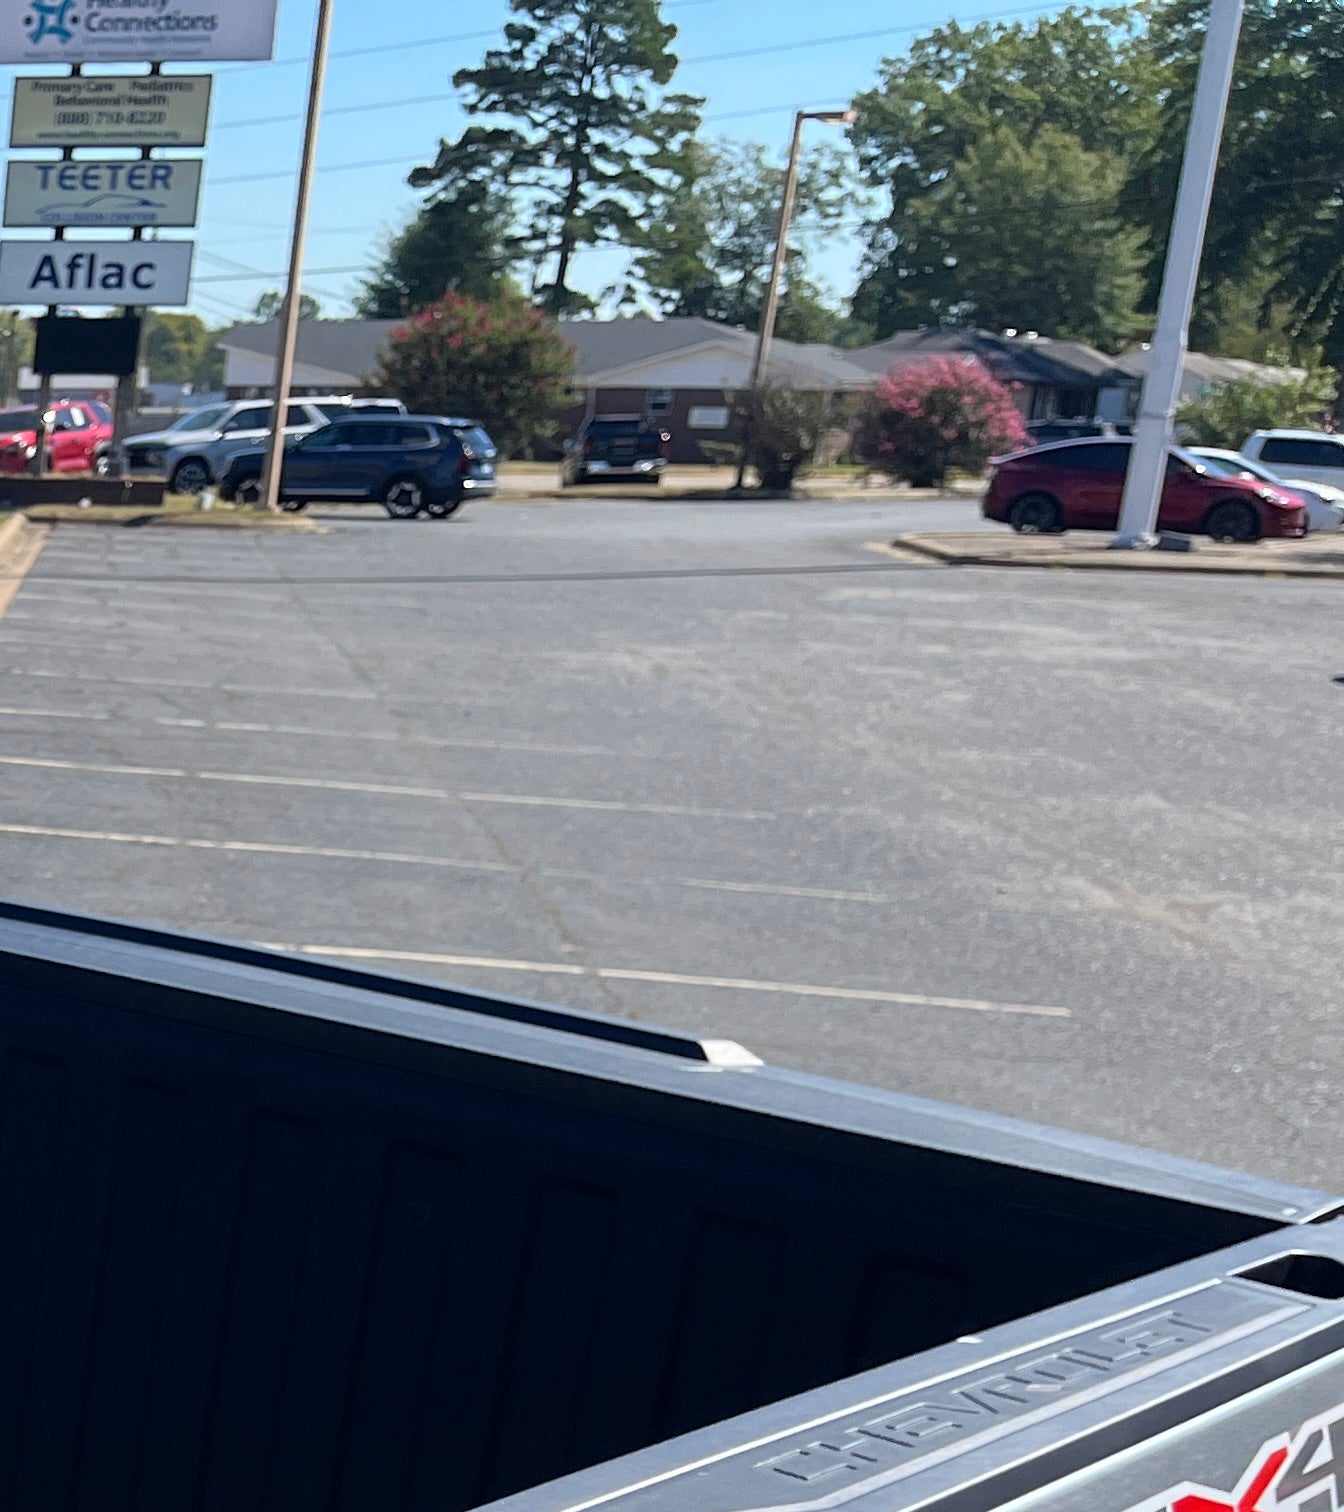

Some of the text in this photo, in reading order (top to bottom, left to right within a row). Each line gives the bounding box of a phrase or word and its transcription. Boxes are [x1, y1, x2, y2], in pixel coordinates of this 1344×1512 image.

[84, 11, 218, 32] Connections
[36, 165, 173, 190] TEETER
[30, 253, 156, 290] Aflac
[752, 1310, 1213, 1482] CHEVROLET
